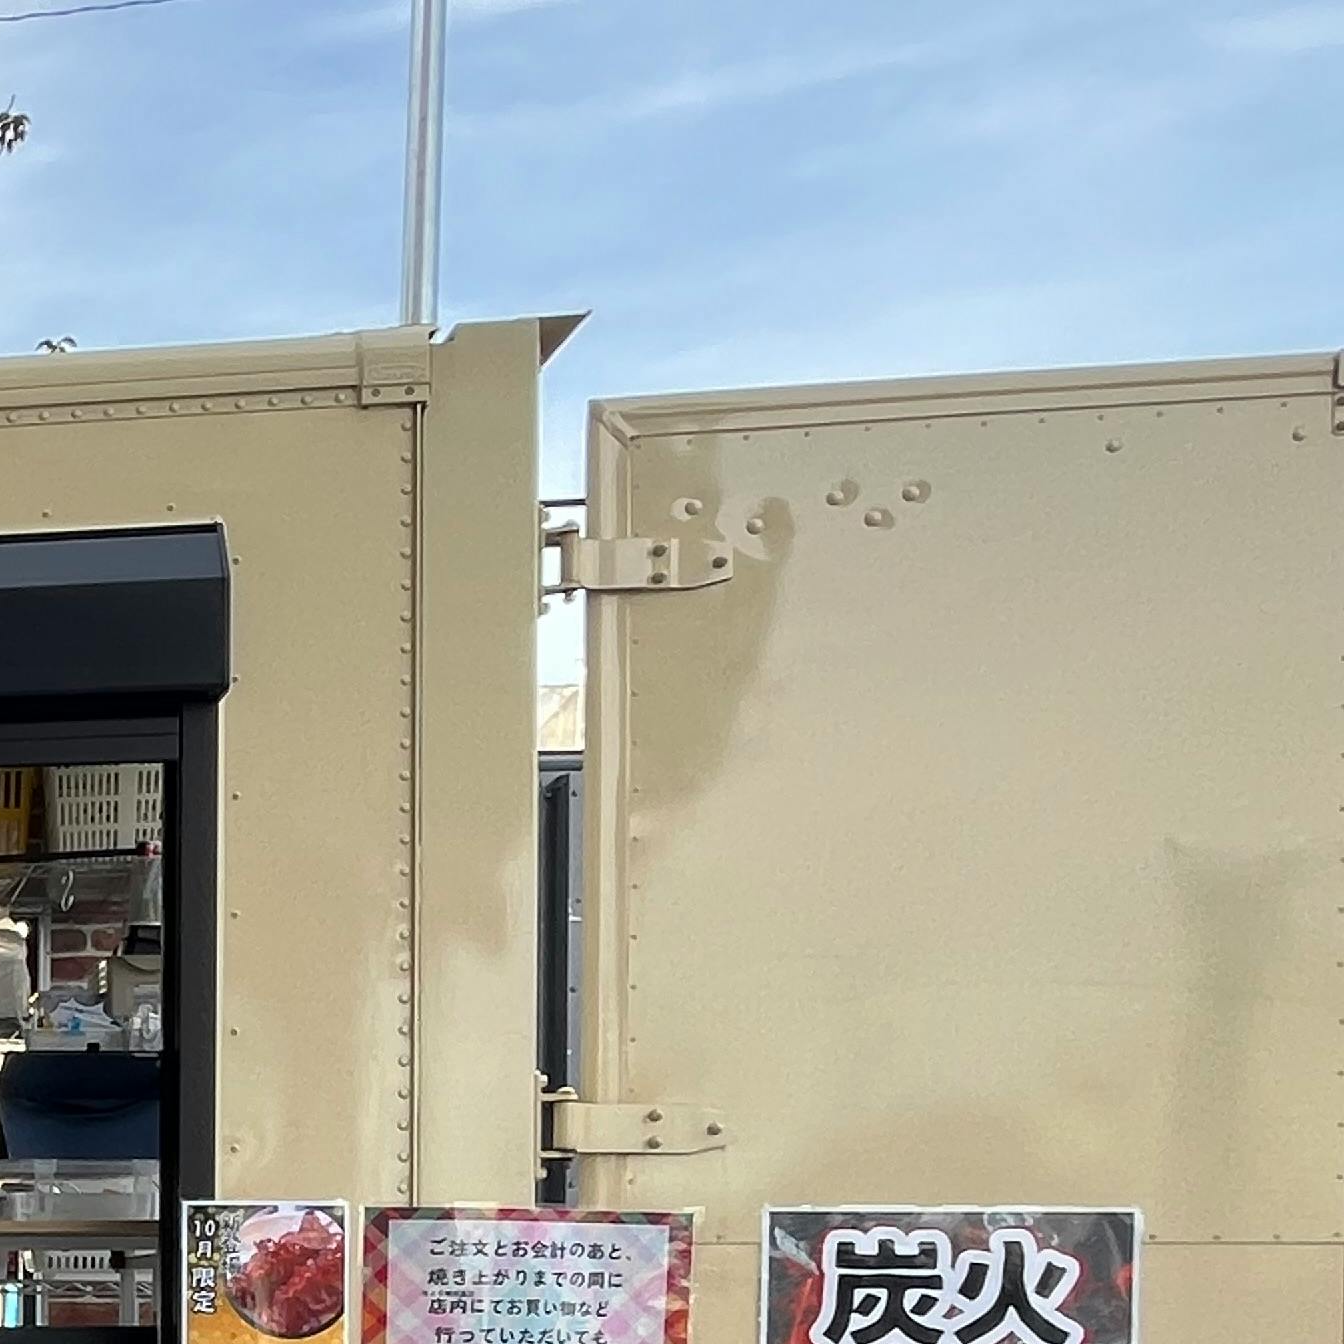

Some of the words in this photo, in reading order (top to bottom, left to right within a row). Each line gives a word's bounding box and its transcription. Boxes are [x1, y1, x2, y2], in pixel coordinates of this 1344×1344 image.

[428, 1237, 631, 1261] ご注文とお会計のあと、
[191, 1219, 216, 1314] 10月限定
[427, 1268, 623, 1288] 焼き上がりまでの間に
[428, 1298, 609, 1318] 店内にてお買い物など
